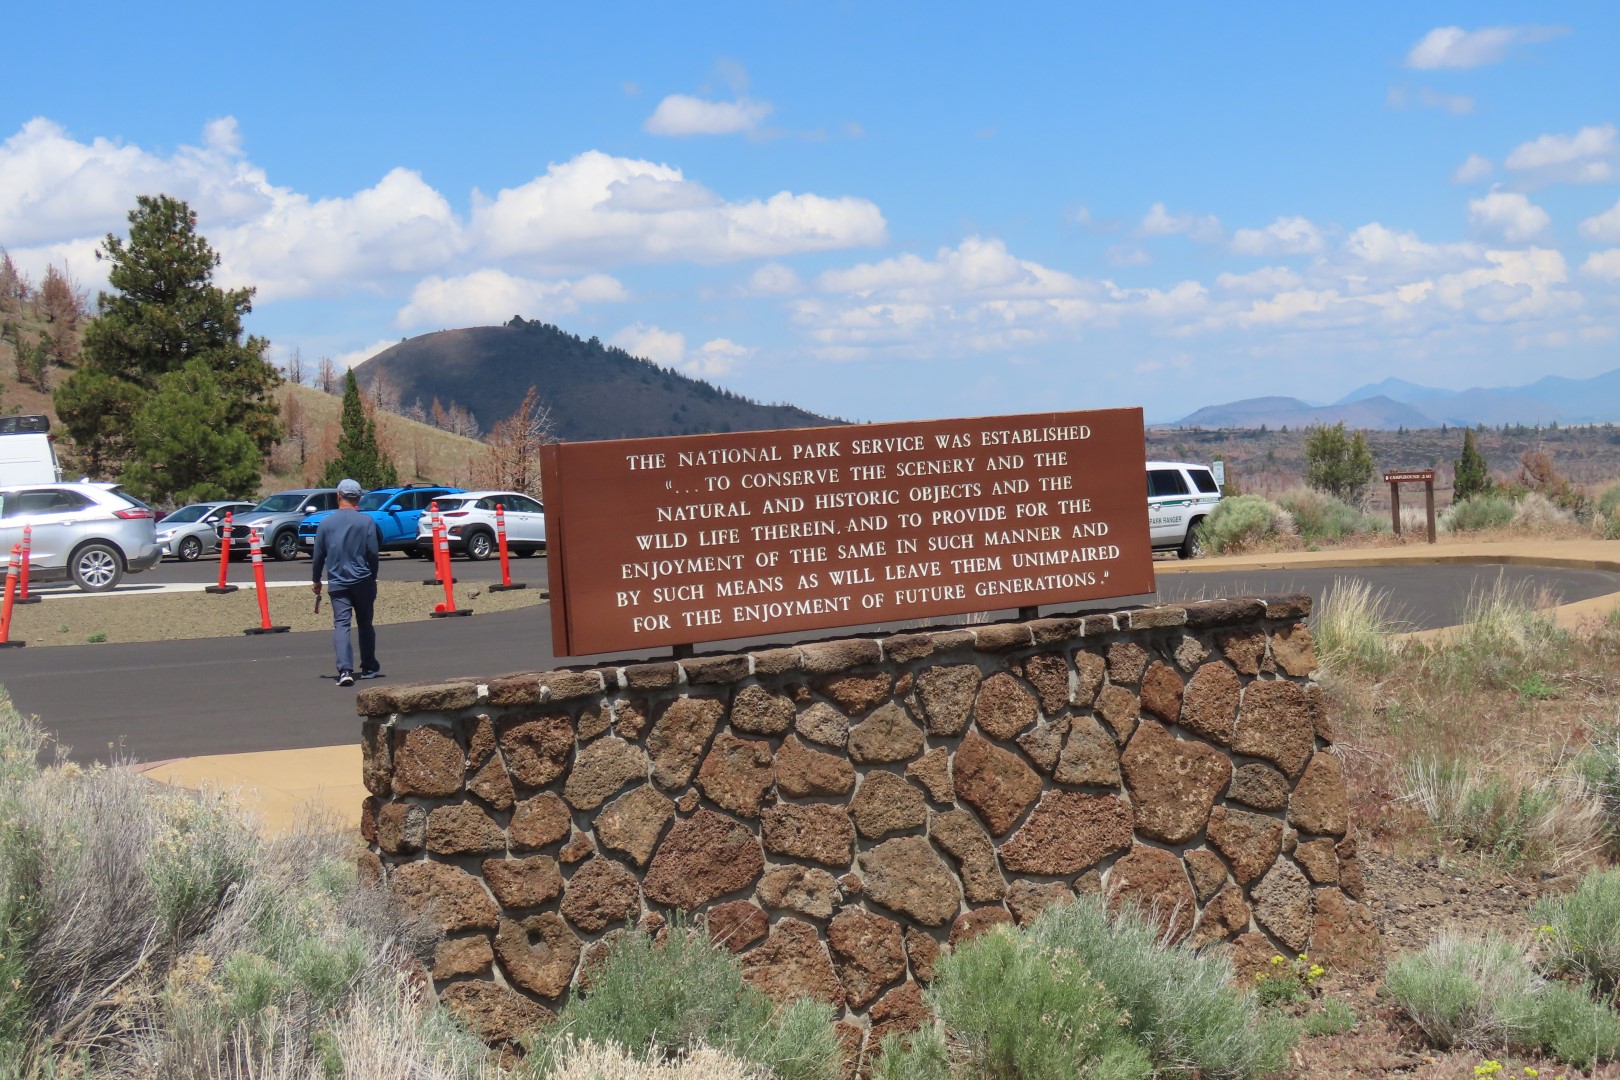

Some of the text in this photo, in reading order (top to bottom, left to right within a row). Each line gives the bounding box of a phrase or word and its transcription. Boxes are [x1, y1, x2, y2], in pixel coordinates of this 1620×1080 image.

[625, 425, 1091, 471] THE NATIONAL PARK SERVICE WAS ESTABLISHED
[704, 475, 731, 492] TO
[741, 468, 840, 489] CONSERVE
[849, 464, 887, 481] THE
[896, 457, 976, 477] SCENERY
[986, 454, 1024, 471] AND
[1033, 451, 1068, 468] THE
[656, 475, 1073, 523] NATURAL AND HISTORIC OBJECTS AND THE
[1163, 515, 1182, 524] RANGER
[635, 532, 688, 551] WILD
[698, 528, 740, 547] LIFE
[847, 515, 888, 533] AND
[897, 512, 922, 528] TO
[931, 505, 1007, 526] PROVIDE
[1015, 501, 1049, 519] FOR
[1057, 498, 1092, 515] THE
[621, 521, 1109, 581] ENJOYMENT OF THE SAME IN SUCH MANNER AND
[615, 544, 1120, 608] BY SUCH MEANS AS WILL LEAVE THEM UNIMPAIRED
[632, 614, 672, 633] FOR
[681, 608, 723, 627] THE
[732, 595, 852, 623] ENJOYMENT
[861, 592, 885, 609] OF
[894, 584, 966, 605] FUTURE
